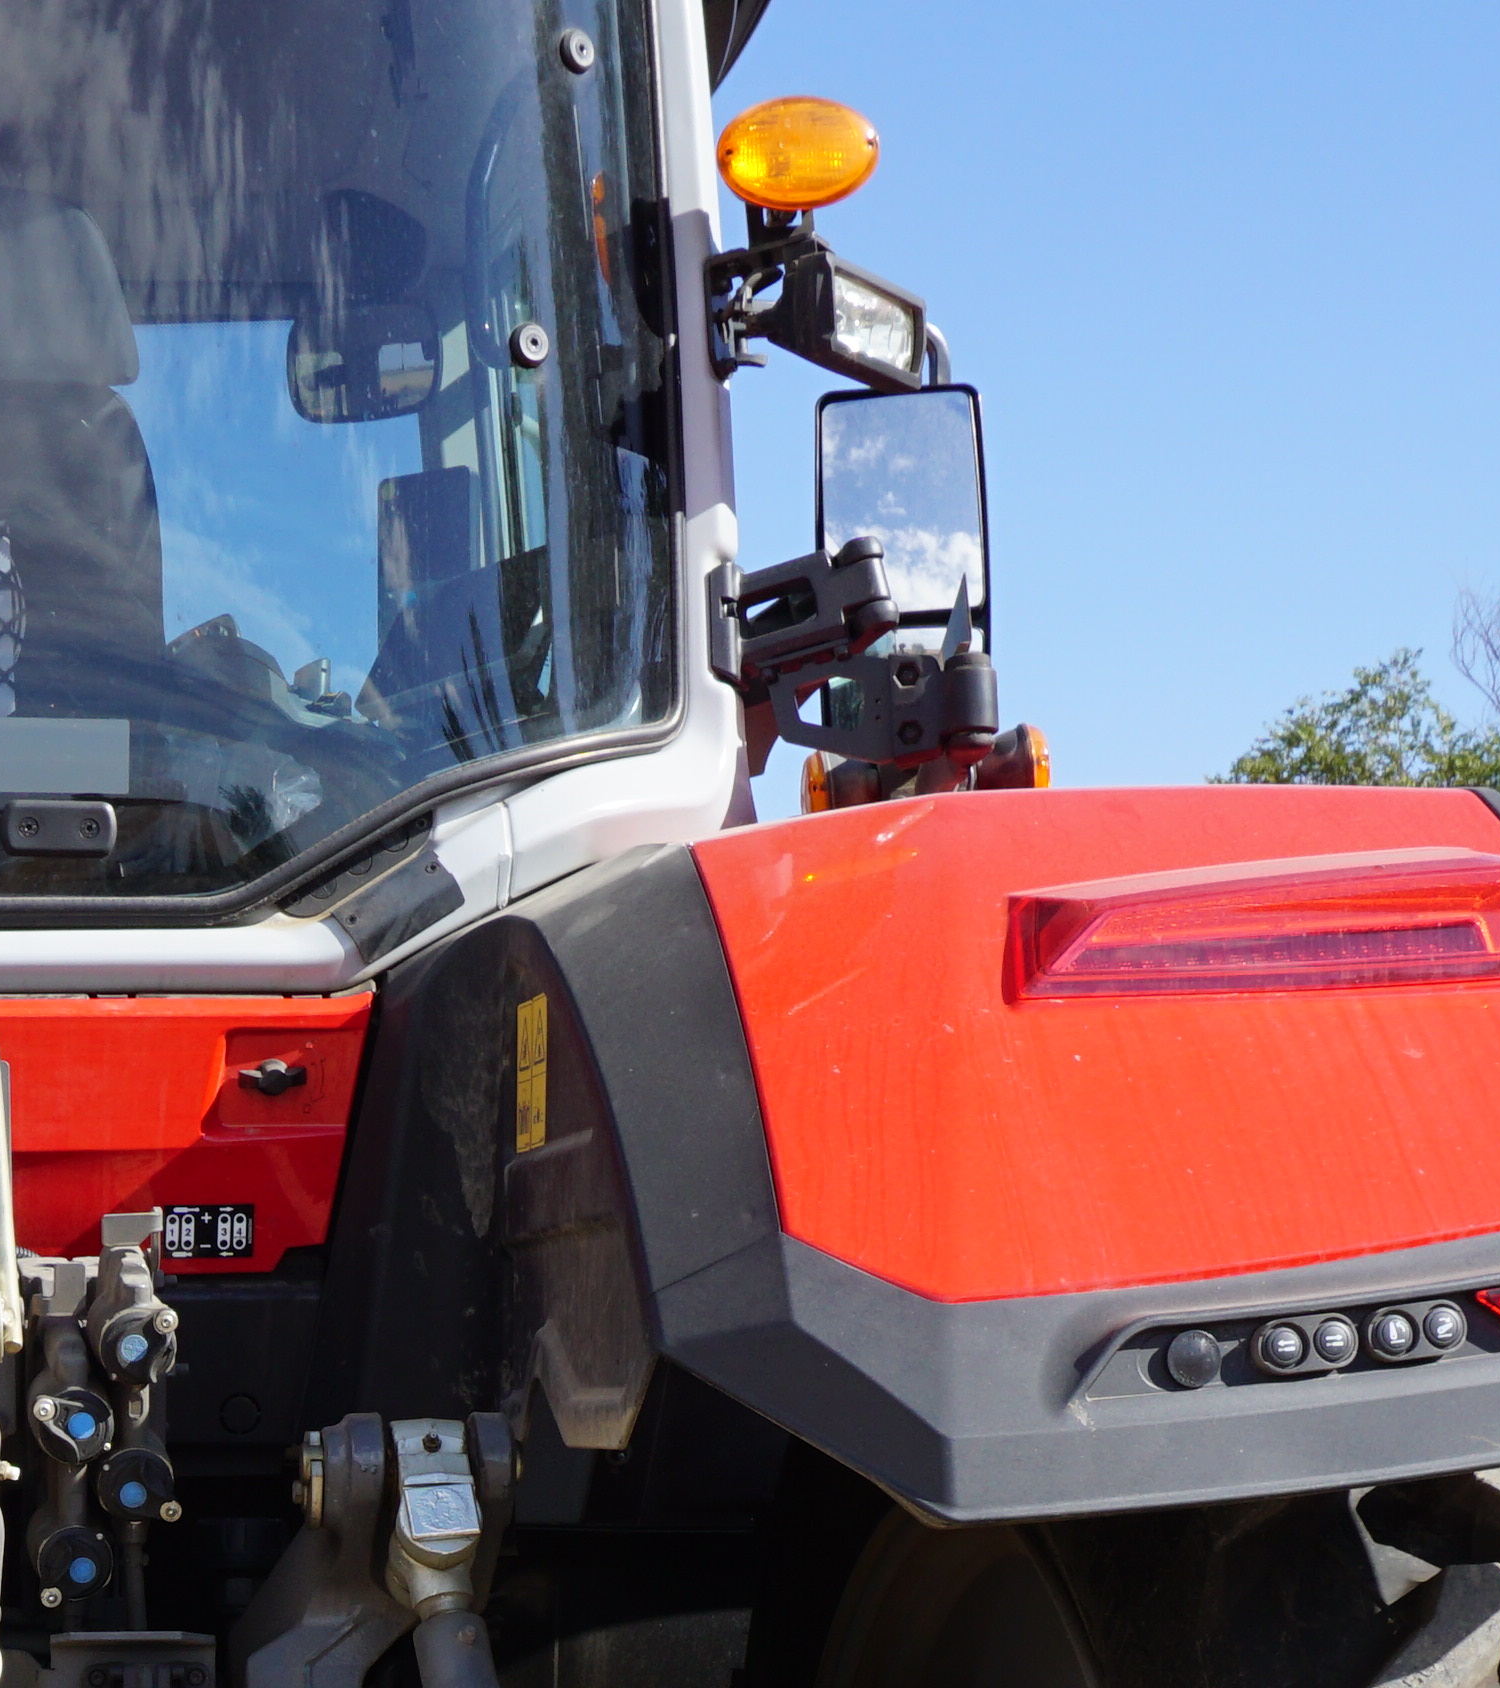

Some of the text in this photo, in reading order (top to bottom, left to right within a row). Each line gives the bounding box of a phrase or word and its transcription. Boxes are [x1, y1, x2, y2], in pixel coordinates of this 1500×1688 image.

[169, 1228, 175, 1237] 1
[184, 1228, 192, 1237] 2
[221, 1227, 228, 1236] 3
[236, 1227, 243, 1236] 4
